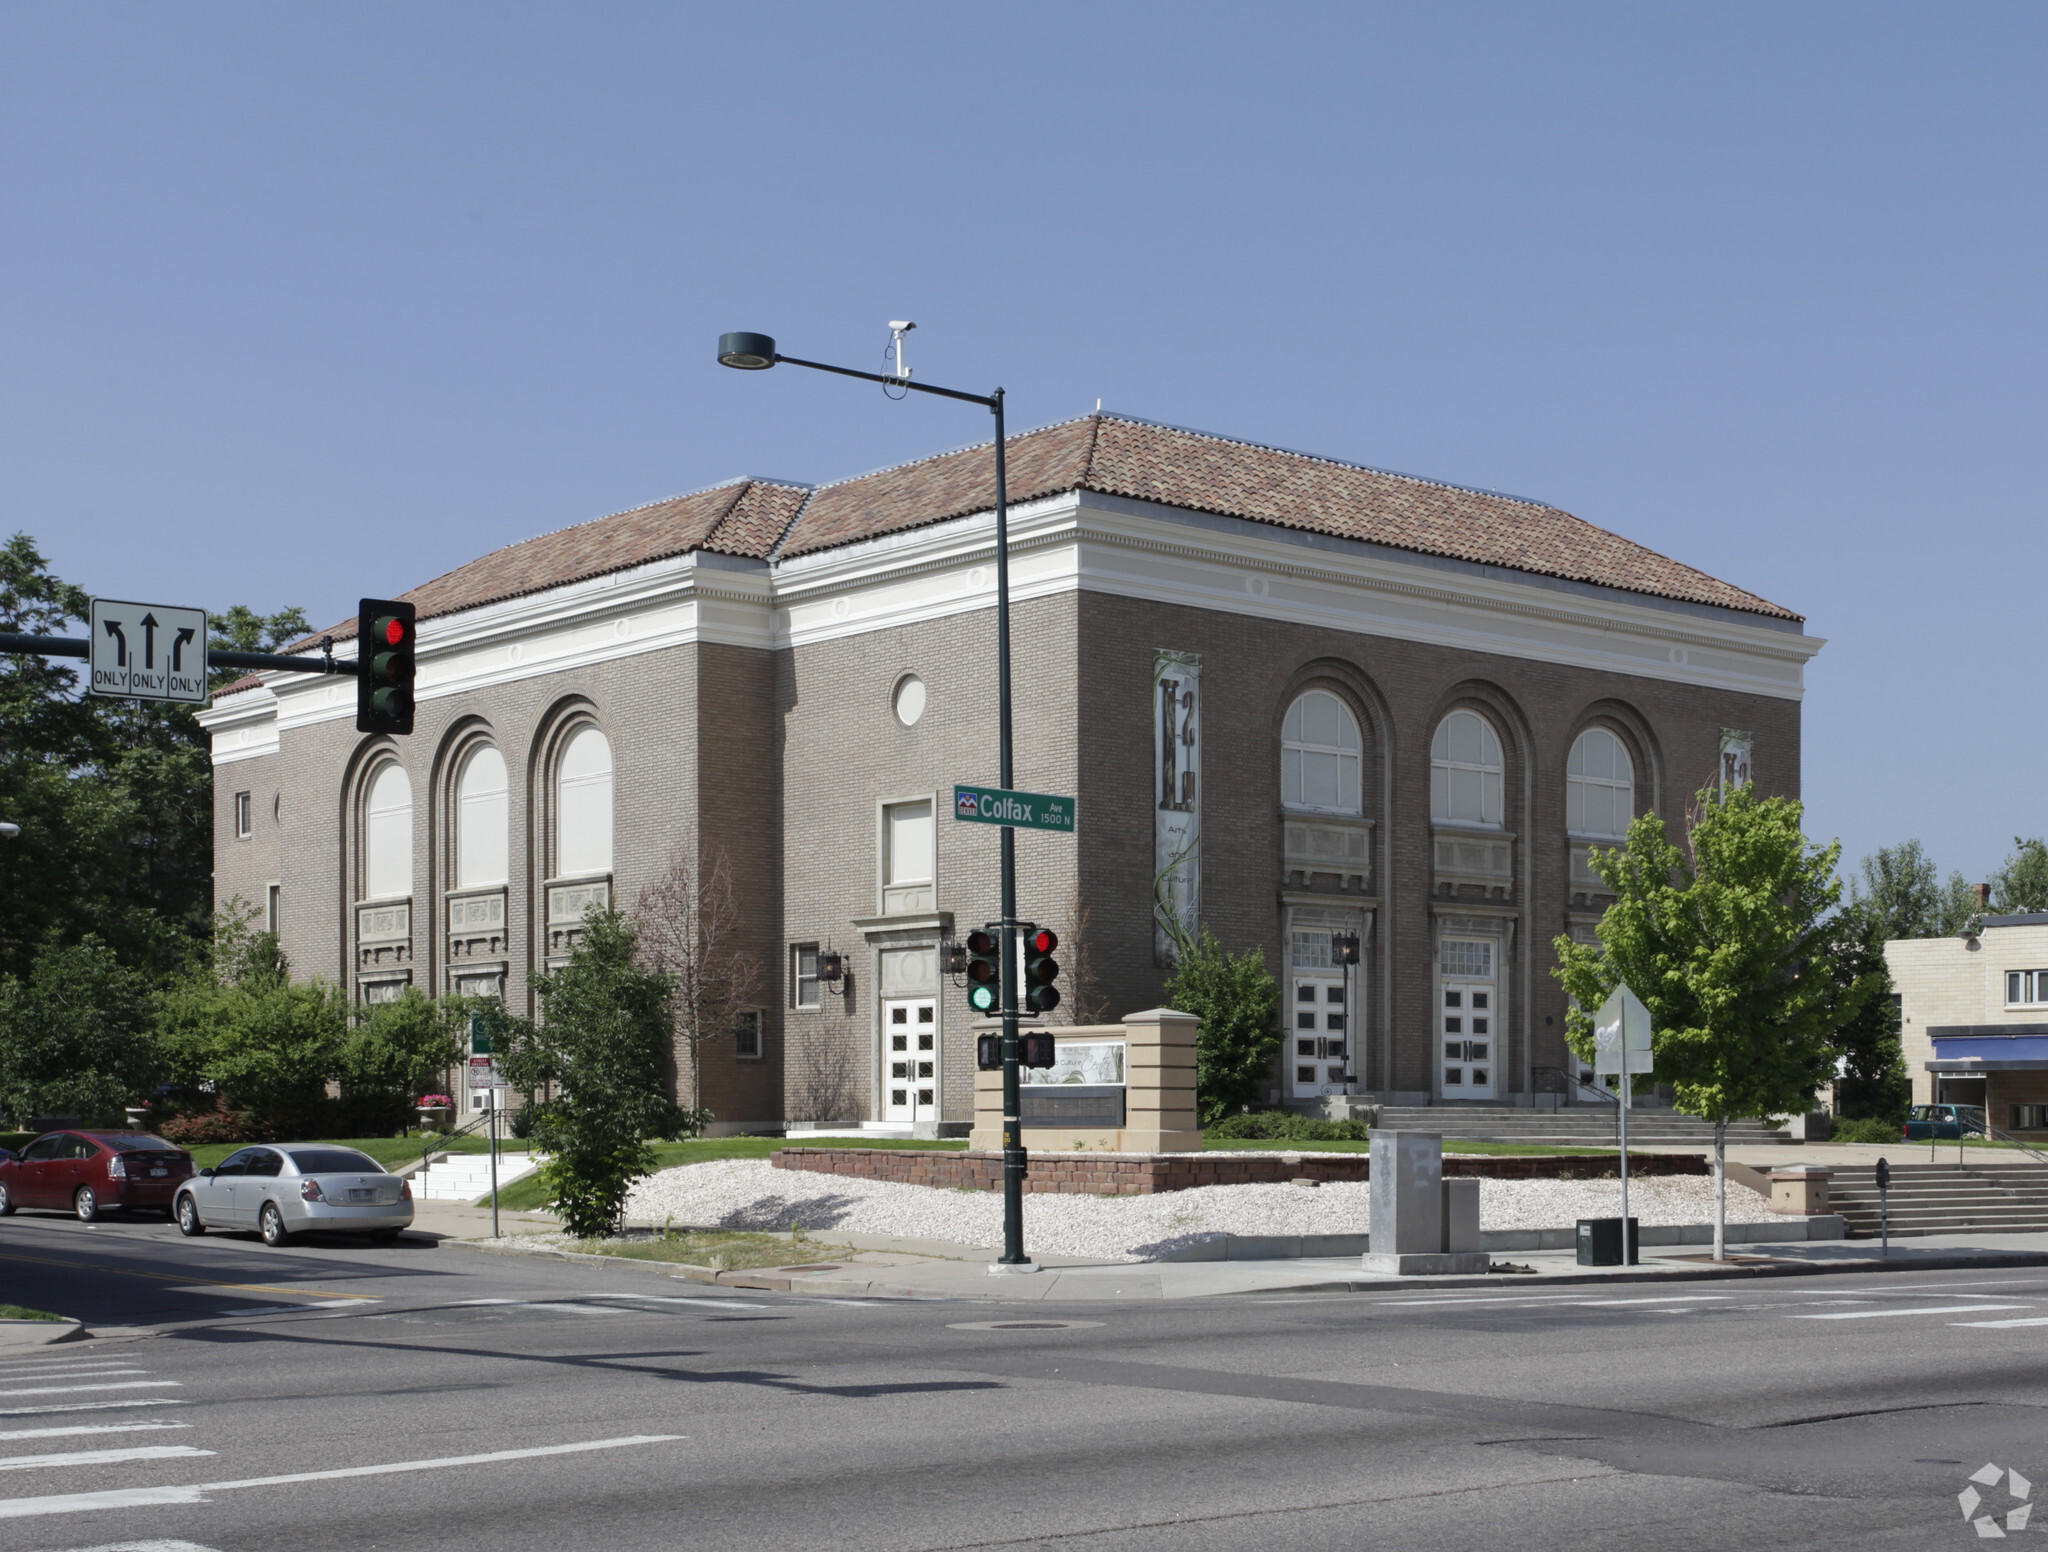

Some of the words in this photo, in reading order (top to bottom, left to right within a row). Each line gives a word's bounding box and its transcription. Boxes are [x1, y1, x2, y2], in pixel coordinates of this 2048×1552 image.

[95, 670, 127, 686] ONLY
[132, 673, 165, 689] ONLY
[170, 676, 202, 692] ONLY
[958, 807, 978, 816] DENVER
[980, 795, 1032, 822] Colfax
[1049, 803, 1063, 813] Ave
[1041, 813, 1062, 824] 1500
[1064, 815, 1070, 825] N
[1168, 826, 1186, 834] Arts
[1168, 850, 1186, 859] and
[1162, 874, 1192, 883] Culture
